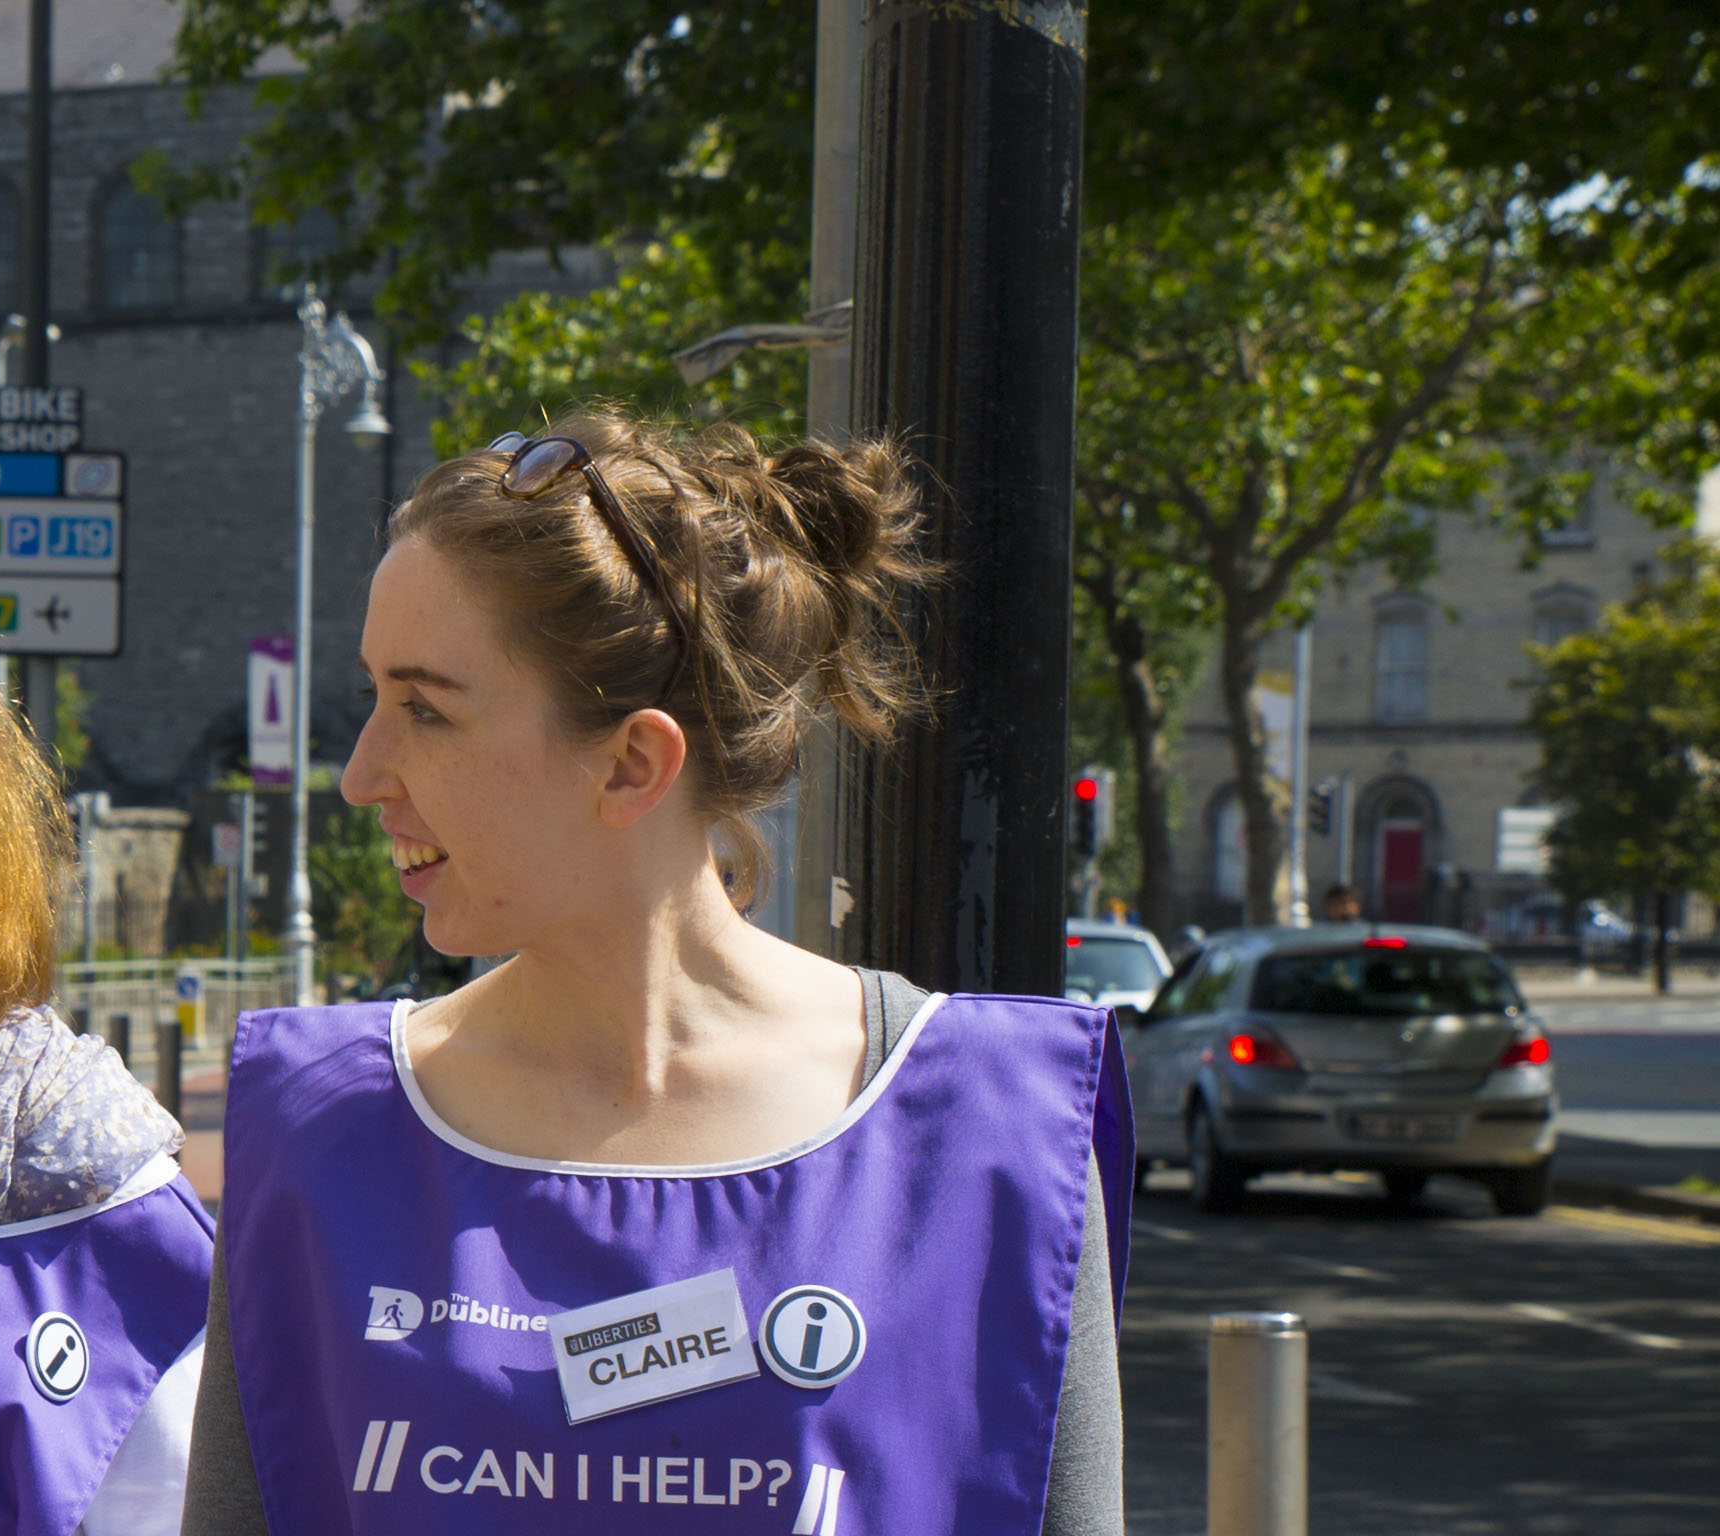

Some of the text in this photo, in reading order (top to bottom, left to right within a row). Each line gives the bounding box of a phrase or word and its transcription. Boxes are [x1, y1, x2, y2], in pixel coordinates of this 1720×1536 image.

[0, 387, 80, 420] BIKE
[50, 520, 110, 549] J19
[450, 1292, 470, 1303] The
[577, 1315, 657, 1350] LIBERTIES
[588, 1325, 732, 1386] CLAIRE
[419, 1445, 793, 1508] CAN I HELP?
